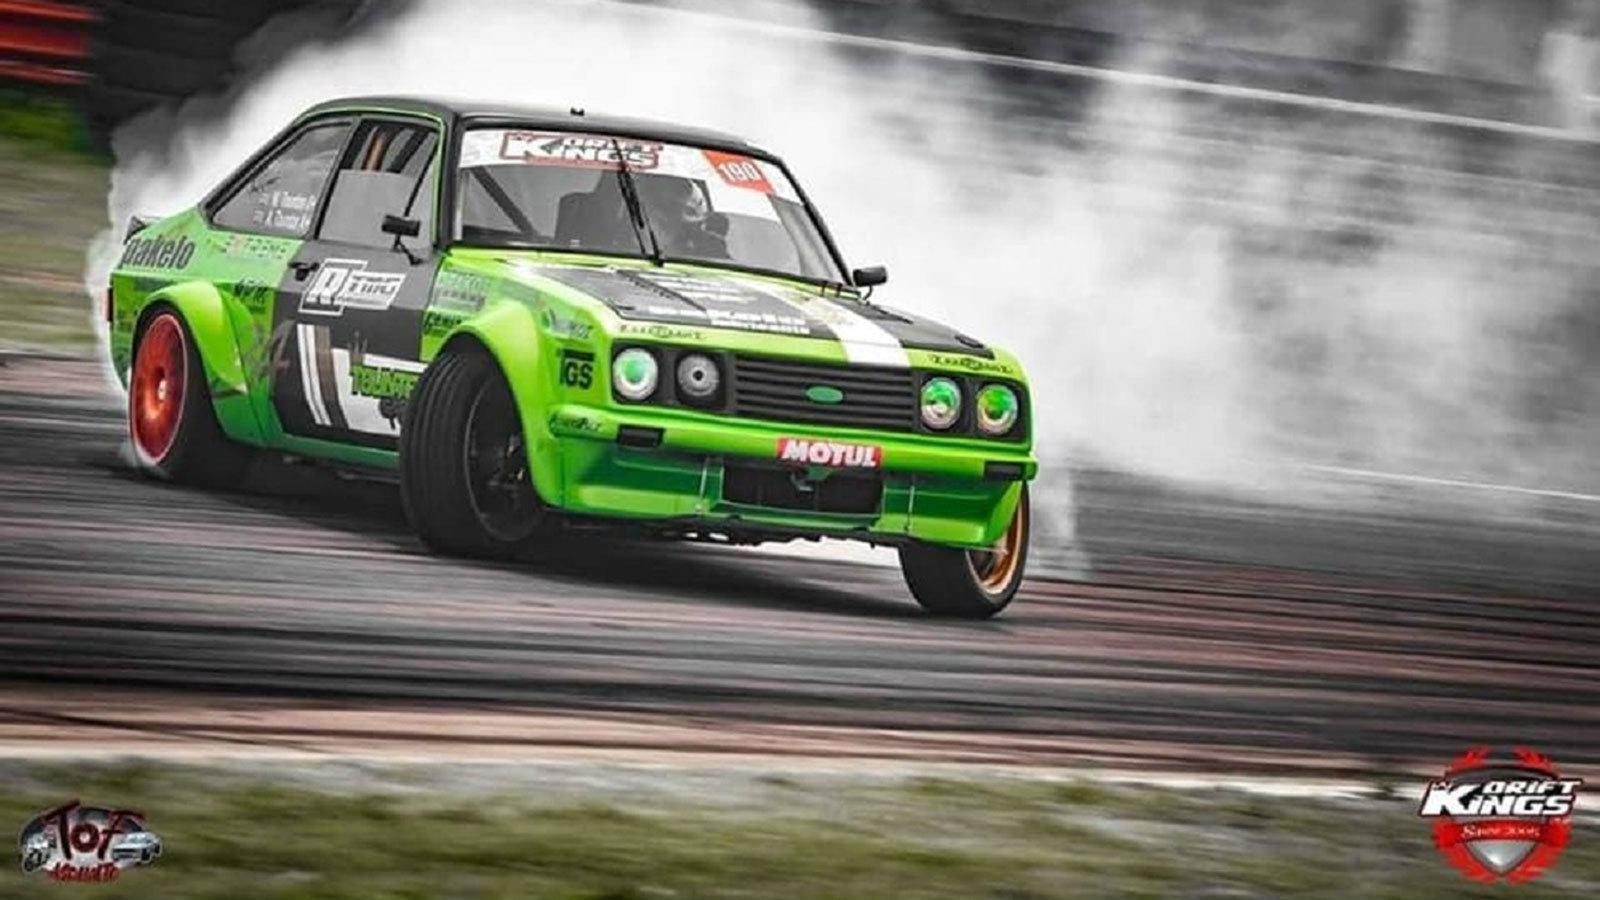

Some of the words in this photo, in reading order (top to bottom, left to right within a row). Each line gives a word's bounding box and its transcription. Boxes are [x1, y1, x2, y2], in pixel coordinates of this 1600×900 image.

[505, 134, 656, 166] KINGS
[719, 161, 765, 183] 190
[119, 234, 196, 271] pakelo
[781, 440, 877, 468] MOTUL
